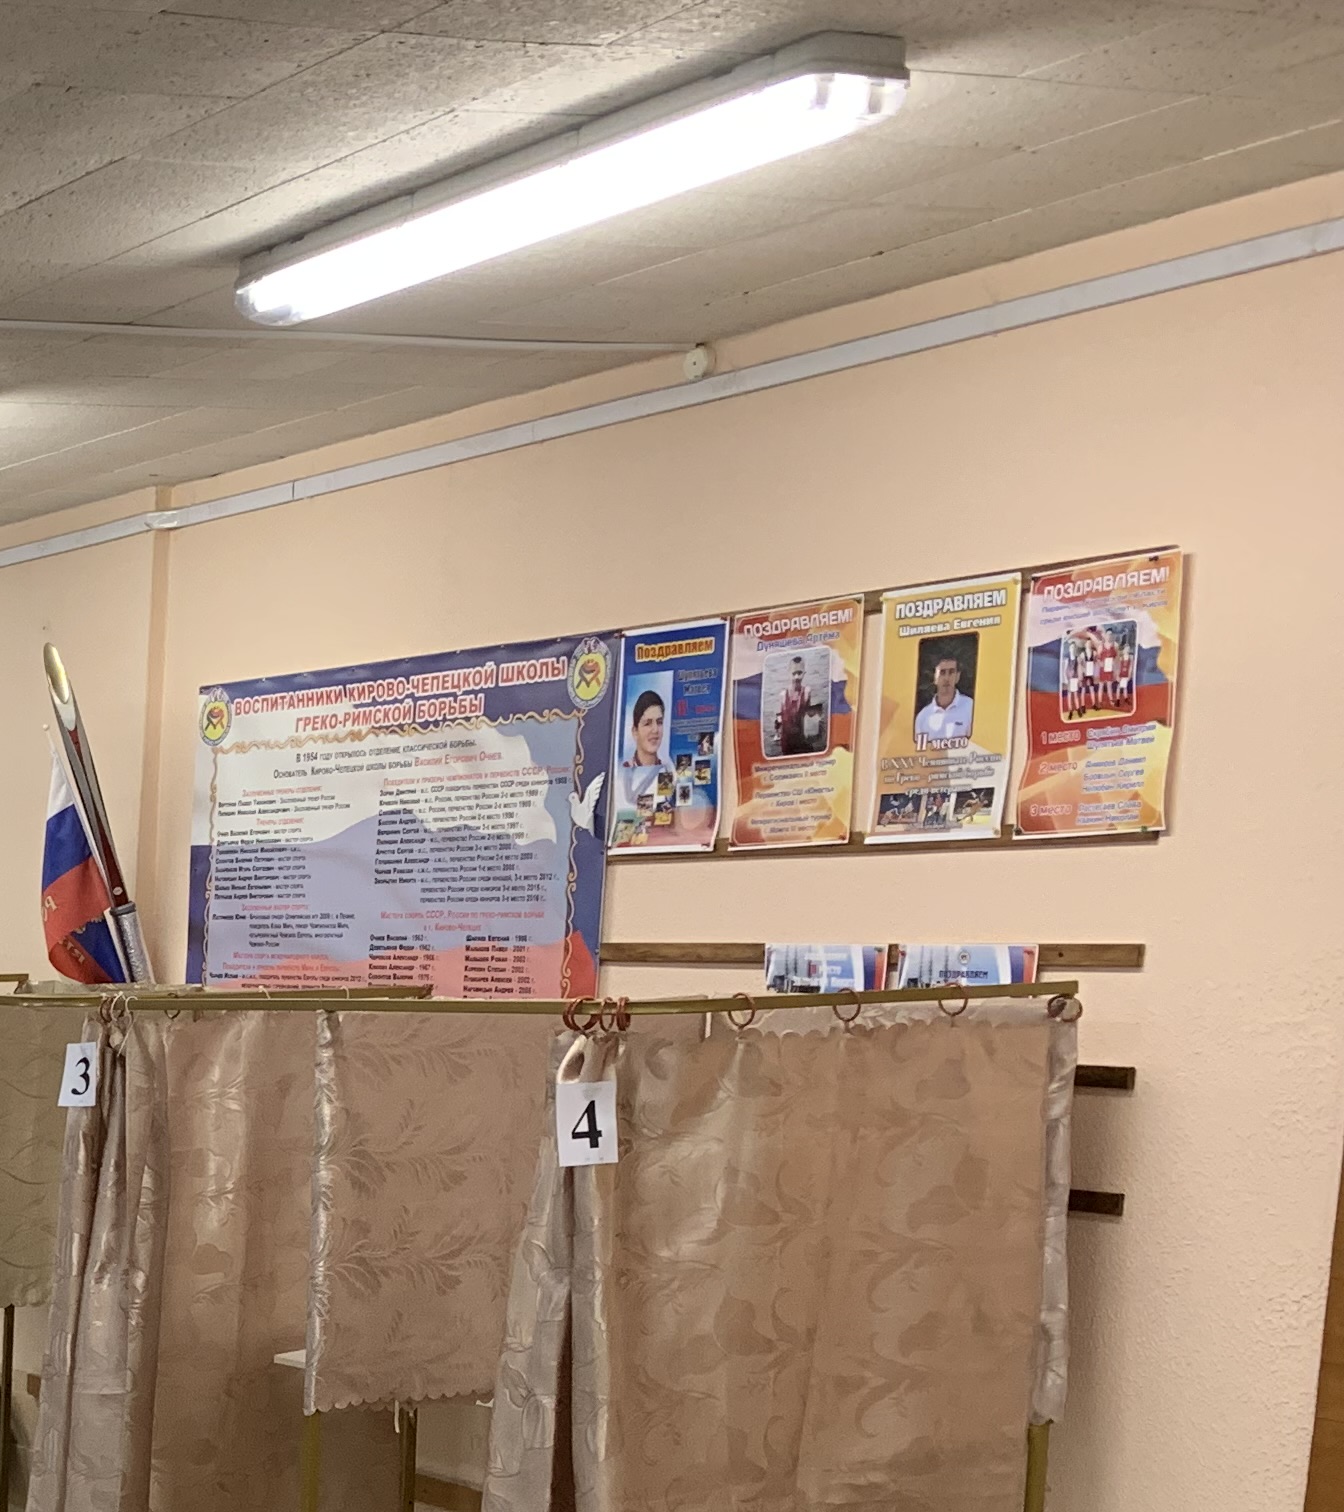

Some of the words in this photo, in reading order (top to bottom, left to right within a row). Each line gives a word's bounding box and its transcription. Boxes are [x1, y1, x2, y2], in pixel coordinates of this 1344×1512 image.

[1044, 566, 1170, 600] ПОЗДРАВЛЯЕМ!
[896, 590, 1006, 618] ПОЗДРАВЛЯЕМ
[744, 608, 854, 638] ПОЗДРАВЛЯЕМ!
[637, 640, 713, 660] Поздравляем
[234, 686, 344, 716] ВОСПИТАННИКИ
[347, 667, 496, 701] КИРОВО-ЧЕПЕЦКОЙ
[499, 658, 568, 684] ШКОЛЫ
[295, 702, 412, 733] ГРЕКО-РИМСКОЙ
[415, 695, 484, 722] БОРЬБЫ
[932, 738, 968, 750] место
[71, 1057, 90, 1095] 3
[572, 1100, 602, 1148] 4
